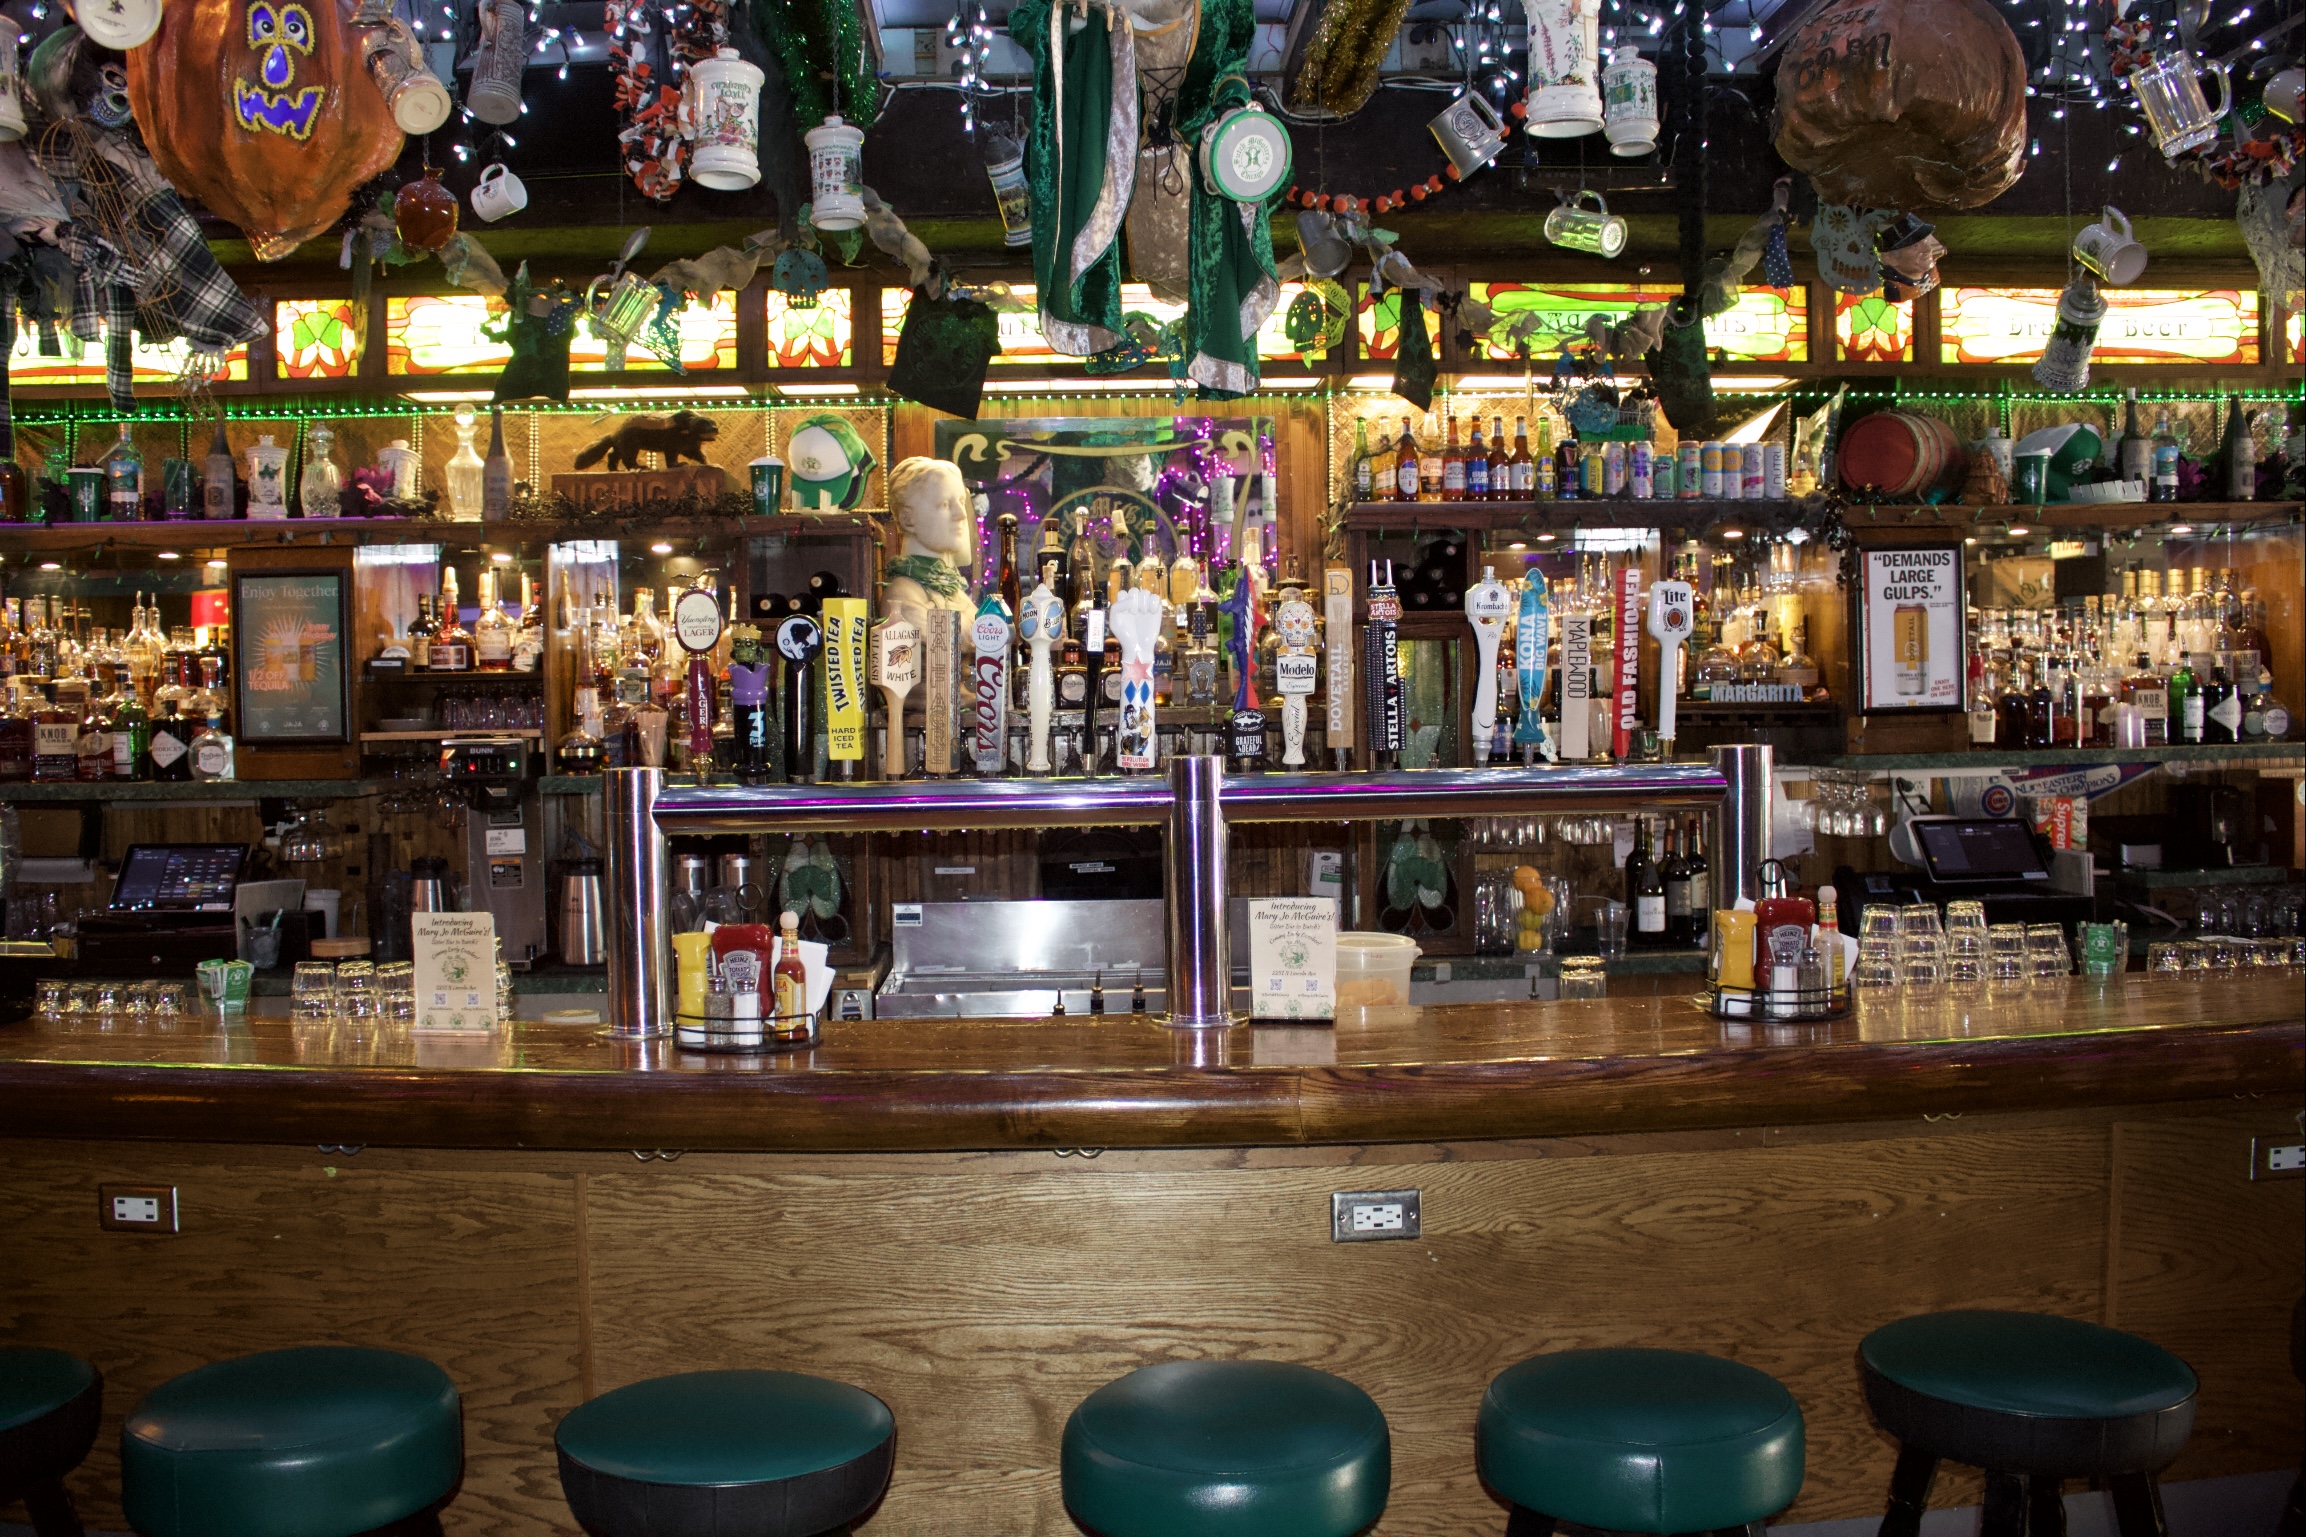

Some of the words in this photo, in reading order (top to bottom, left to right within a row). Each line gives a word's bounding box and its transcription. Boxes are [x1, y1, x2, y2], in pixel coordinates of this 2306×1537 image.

[2124, 319, 2188, 338] Beer
[1890, 569, 1935, 584] LARGE
[241, 586, 277, 601] Enjoy
[280, 584, 338, 598] Together.
[1664, 590, 1687, 606] Lite
[1370, 602, 1396, 611] STELLA
[1370, 608, 1397, 617] ARTOIS
[684, 628, 715, 637] LAGER
[826, 616, 841, 644] TEA
[851, 616, 866, 644] TEA
[976, 624, 1004, 635] Coors
[1535, 612, 1547, 650] WAVE
[1622, 568, 1641, 686] FASHIONED
[883, 629, 920, 641] ALLAGASH
[1519, 614, 1536, 671] KONA
[1908, 615, 1916, 661] DOVETAIL
[1385, 630, 1398, 690] ARTOIS
[1535, 649, 1545, 671] BIG
[1567, 620, 1588, 699] MAPLEWOOD
[266, 671, 285, 681] OFF
[886, 669, 917, 682] WHITE
[1279, 663, 1315, 676] Modelo
[248, 681, 290, 691] TEQUILA
[827, 647, 850, 712] TWISTED
[1330, 643, 1343, 732] DOVETAIL
[1709, 684, 1805, 703] MARGARITA
[698, 680, 708, 725] LAGER
[976, 655, 1004, 753] Coors
[2138, 693, 2160, 704] KNOB
[1620, 689, 1637, 730] OLD
[1386, 695, 1400, 750] STELLA
[40, 727, 67, 739] KNOB
[1235, 735, 1263, 746] GRATEFUL
[836, 742, 854, 750] TEA
[1241, 744, 1257, 753] DEAD
[2043, 772, 2087, 790] EASTERN
[1270, 901, 1317, 912] Introducing
[431, 917, 474, 930] Introducing
[1254, 911, 1279, 923] Mary
[1279, 912, 1290, 921] Jo
[417, 927, 439, 938] Mary
[439, 927, 449, 937] Jo
[1779, 930, 1798, 938] HEINZ
[729, 956, 749, 964] HEINZ
